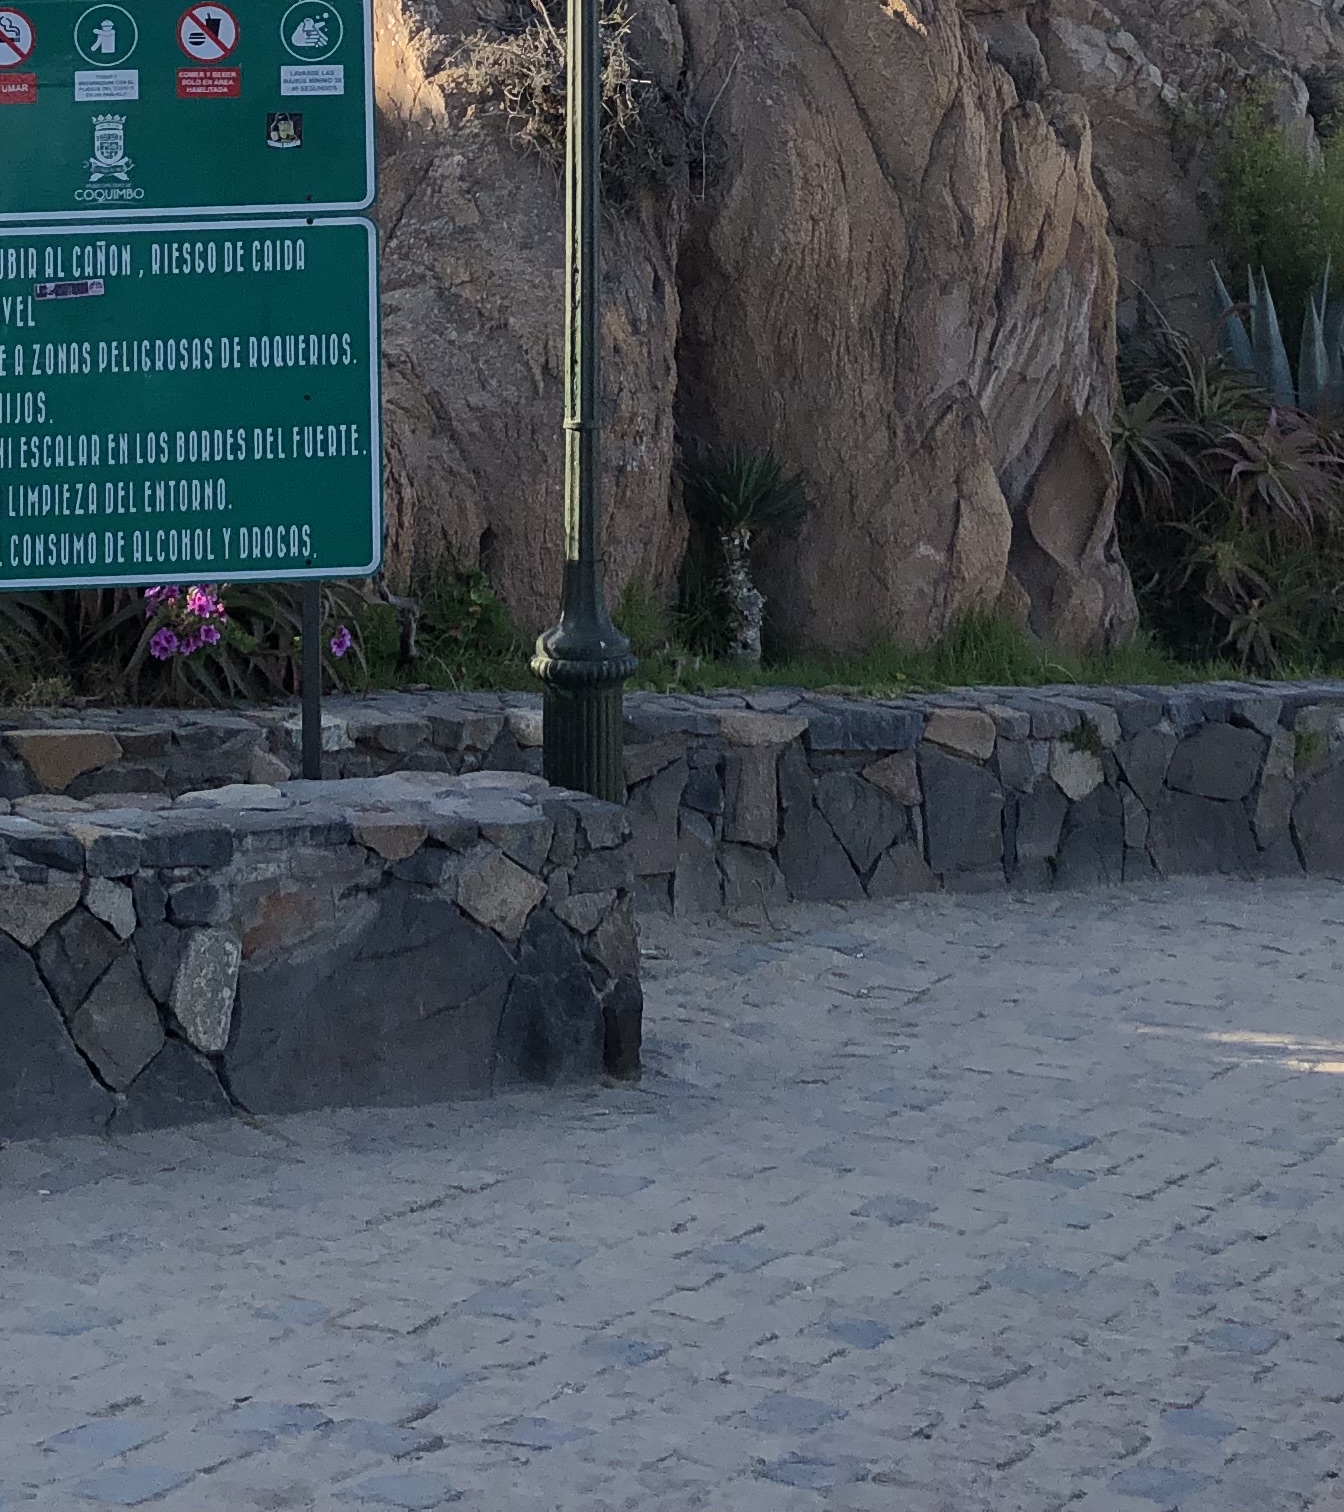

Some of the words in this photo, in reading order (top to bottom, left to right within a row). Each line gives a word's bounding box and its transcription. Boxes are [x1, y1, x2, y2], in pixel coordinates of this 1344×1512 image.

[74, 188, 145, 203] COQUIMBO
[44, 246, 65, 278] AL
[151, 241, 217, 275] RIESGO
[224, 241, 244, 273] DE
[252, 238, 305, 272] CAIDA
[14, 344, 24, 376] A
[31, 341, 91, 376] ZONAS
[98, 337, 213, 373] PELIGROSAS
[221, 336, 241, 369] DE
[249, 333, 357, 368] ROQUERIOS.
[20, 434, 100, 468] ESCALAR
[107, 433, 128, 465] EN
[136, 431, 169, 464] LOS
[176, 428, 246, 463] BORDES
[253, 427, 286, 460] DEL
[292, 424, 367, 458] FUERTE.
[8, 482, 97, 517] LIMPIEZA
[105, 481, 137, 514] DEL
[144, 477, 232, 513] ENTORNO.
[10, 531, 97, 567] CONSUMO
[104, 531, 125, 564] DE
[133, 528, 215, 563] ALCOHOL
[222, 527, 231, 560] Y
[239, 524, 317, 559] DROGAS.
